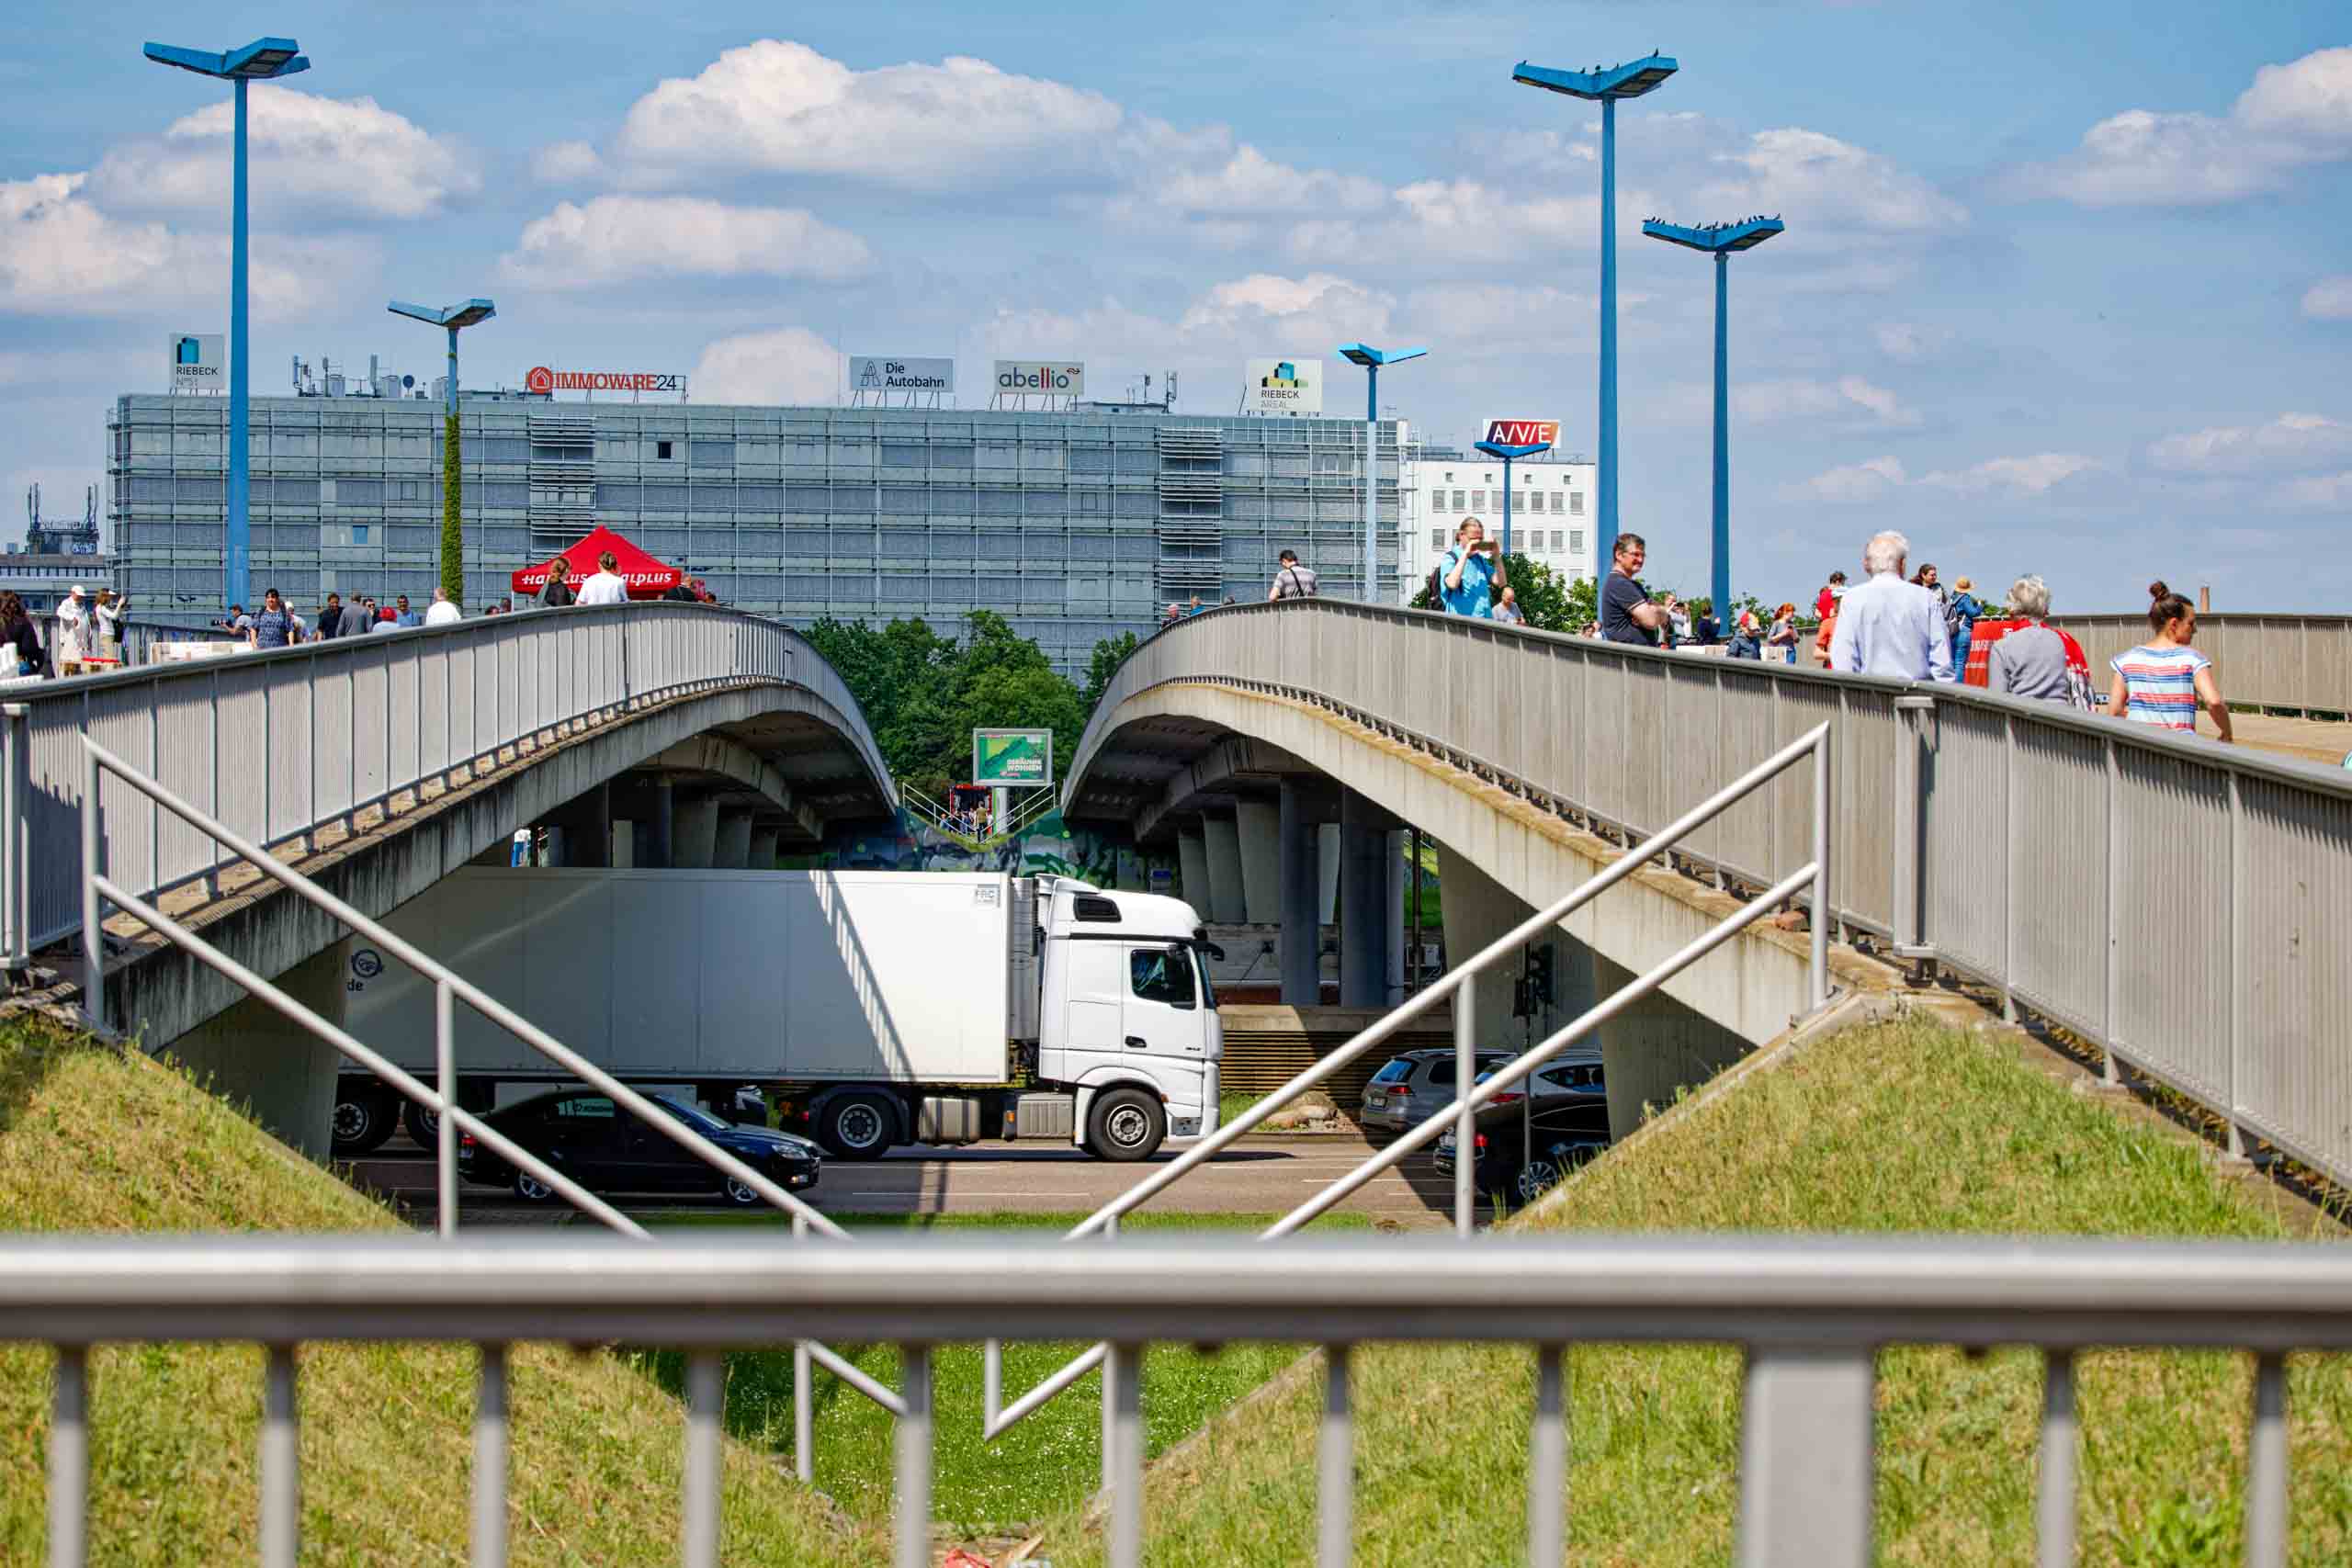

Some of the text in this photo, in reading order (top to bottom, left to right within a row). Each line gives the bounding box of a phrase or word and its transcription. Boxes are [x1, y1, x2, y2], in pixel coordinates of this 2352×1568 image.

[176, 367, 218, 376] RIEBECK
[886, 362, 905, 374] Die
[555, 372, 677, 391] IMMOWARE24
[886, 376, 944, 388] Autobahn
[999, 367, 1069, 389] abellio
[1261, 389, 1300, 399] RIEBECK
[1492, 423, 1552, 444] A/V/E
